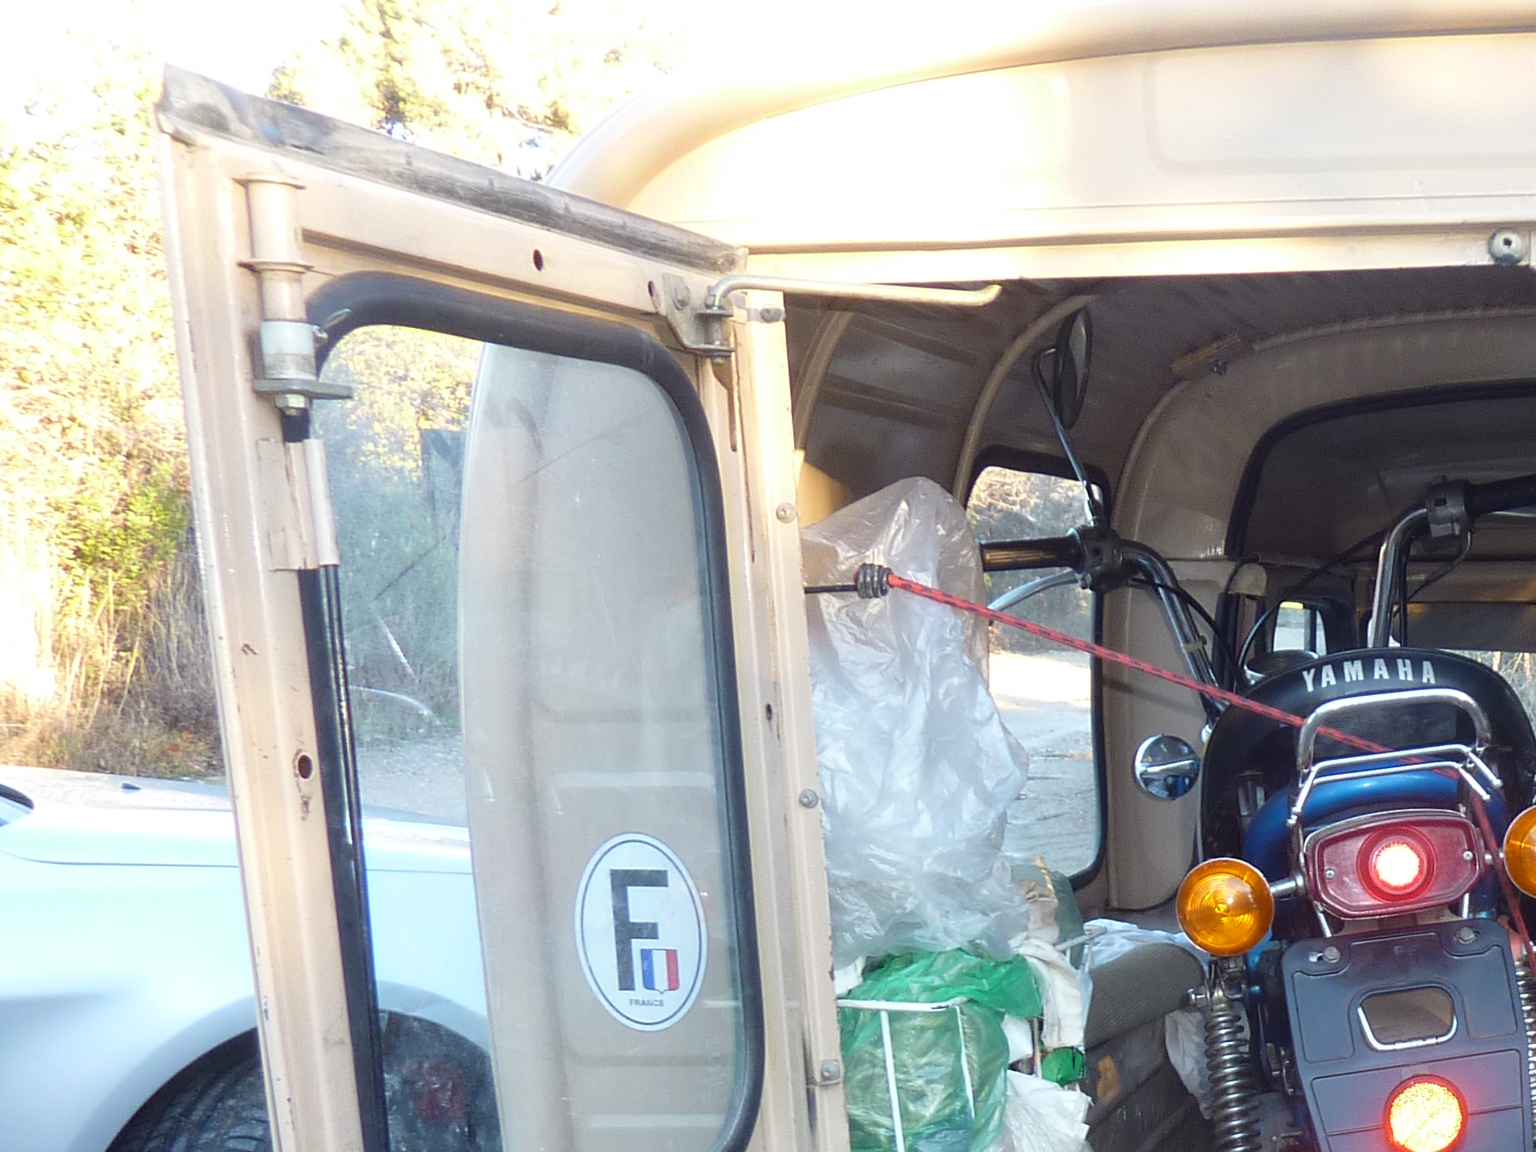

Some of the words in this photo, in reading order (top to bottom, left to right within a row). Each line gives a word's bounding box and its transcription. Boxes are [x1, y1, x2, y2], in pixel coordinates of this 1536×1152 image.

[1302, 658, 1436, 692] YAMAHA
[609, 868, 669, 991] F
[629, 998, 665, 1008] FRANCE
